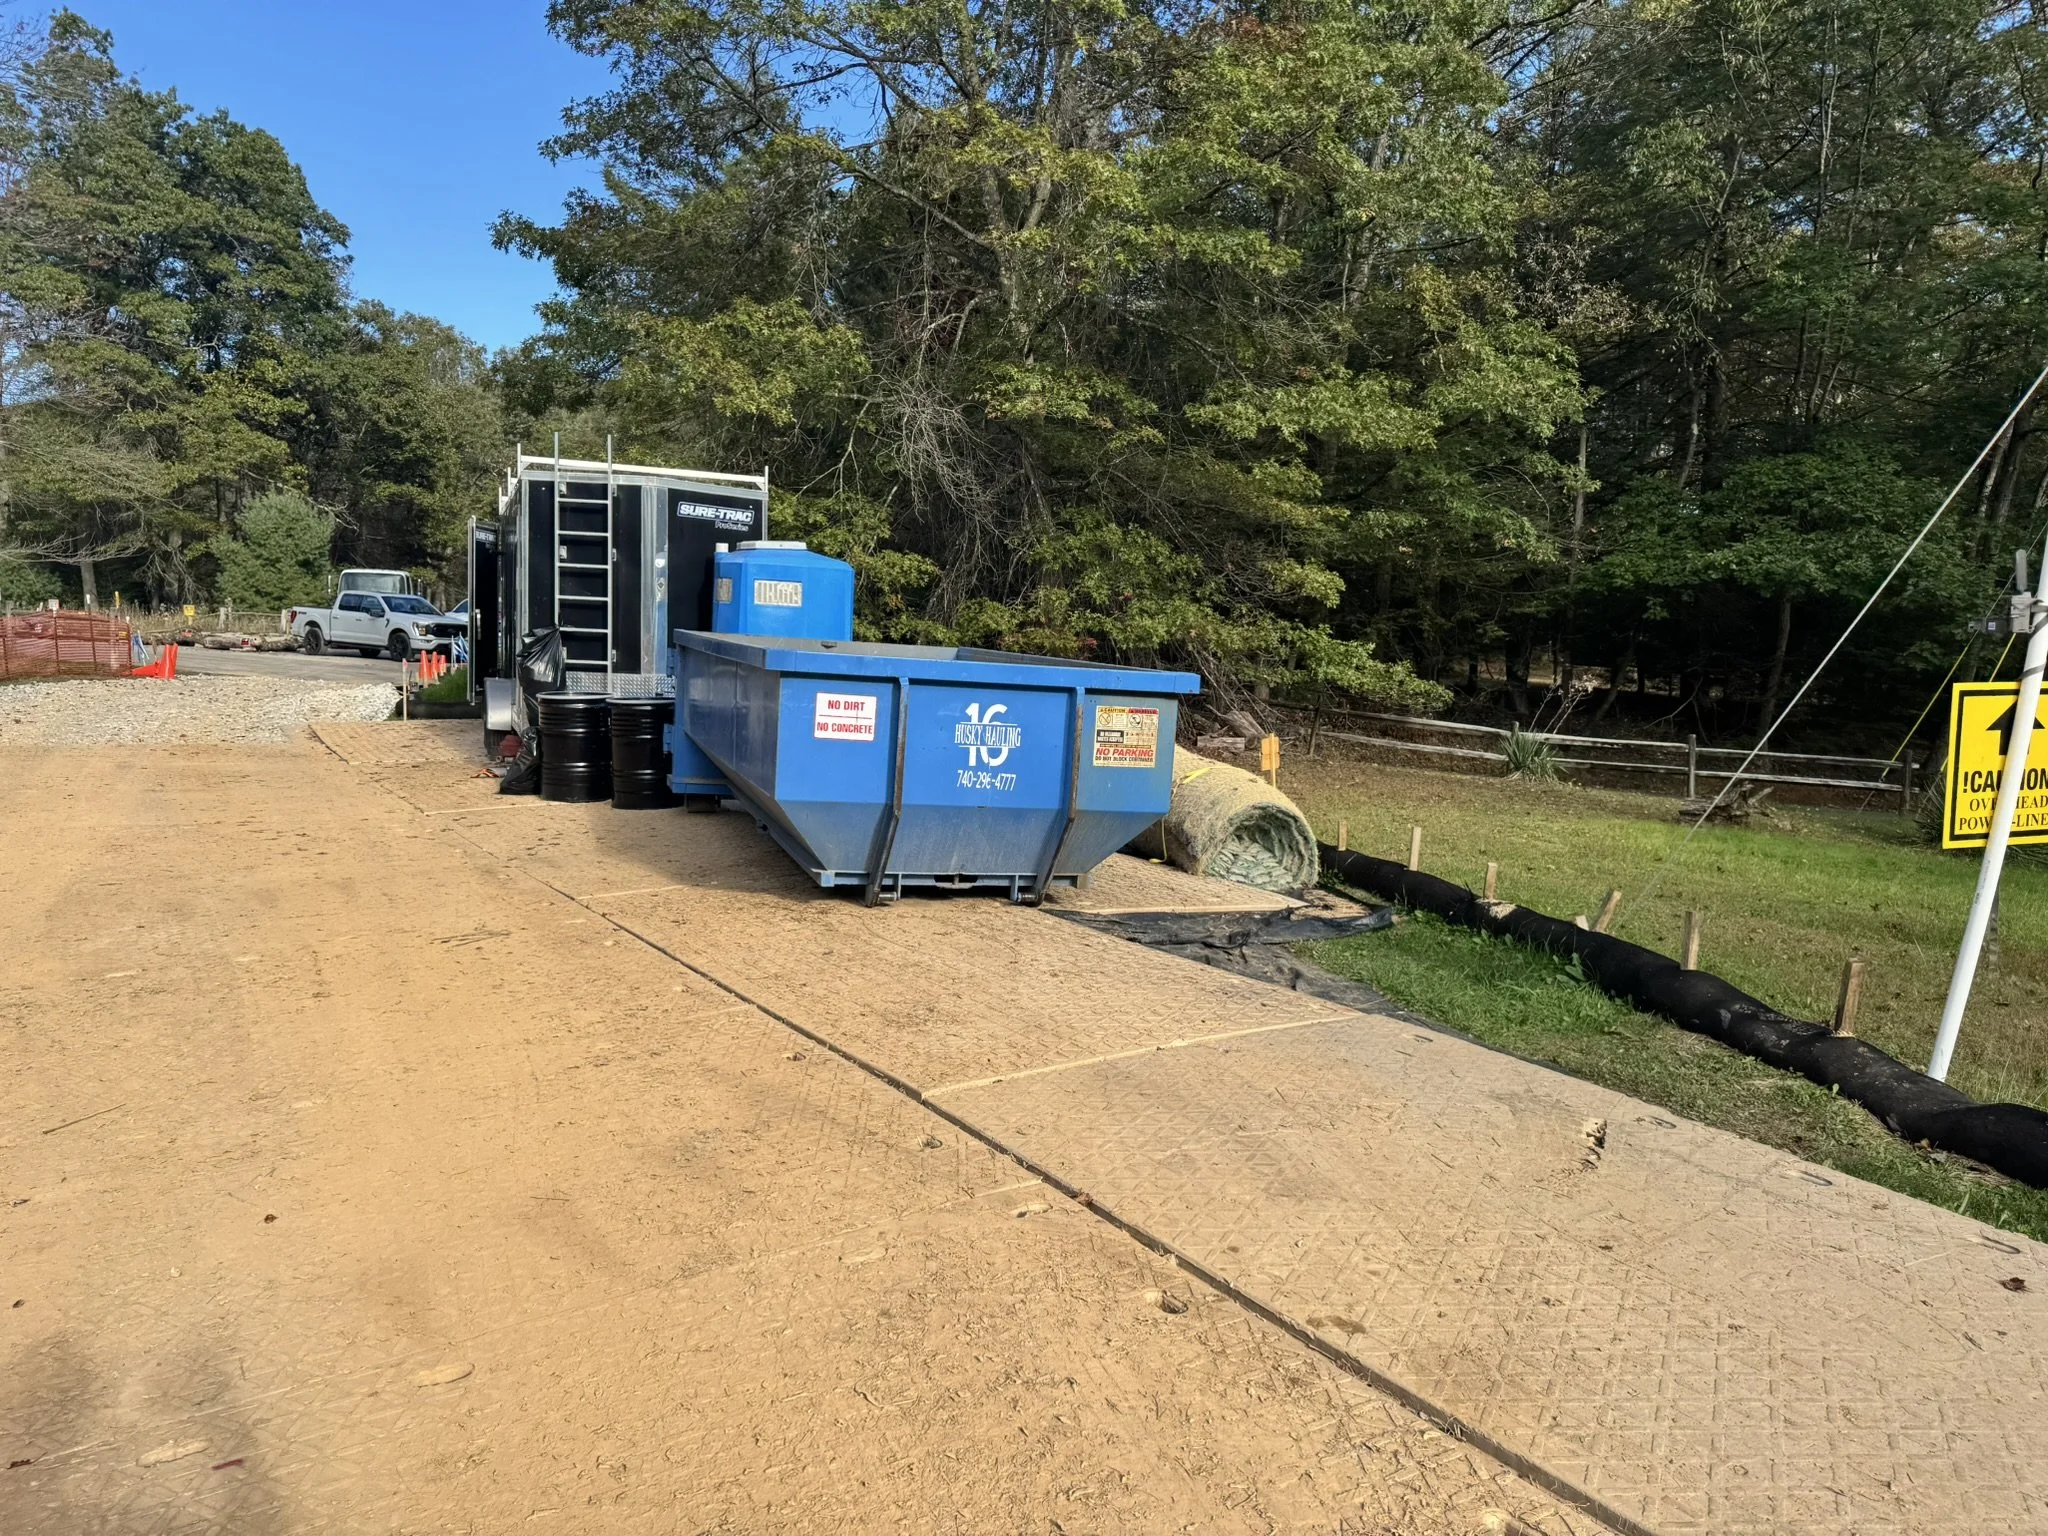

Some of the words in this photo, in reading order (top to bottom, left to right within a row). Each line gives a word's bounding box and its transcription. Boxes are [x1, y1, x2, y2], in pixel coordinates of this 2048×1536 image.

[680, 504, 752, 522] SURE-TRAC
[828, 700, 841, 710] NO
[844, 701, 866, 711] DIRT
[817, 722, 829, 732] NO
[832, 723, 873, 734] CONCRETE
[954, 724, 983, 745] HUSKY
[985, 726, 1022, 747] HAULING
[1096, 748, 1110, 756] NO
[1112, 749, 1154, 757] PARKING
[1963, 768, 2048, 793] !CAION
[1959, 813, 2048, 831] POW-LINE
